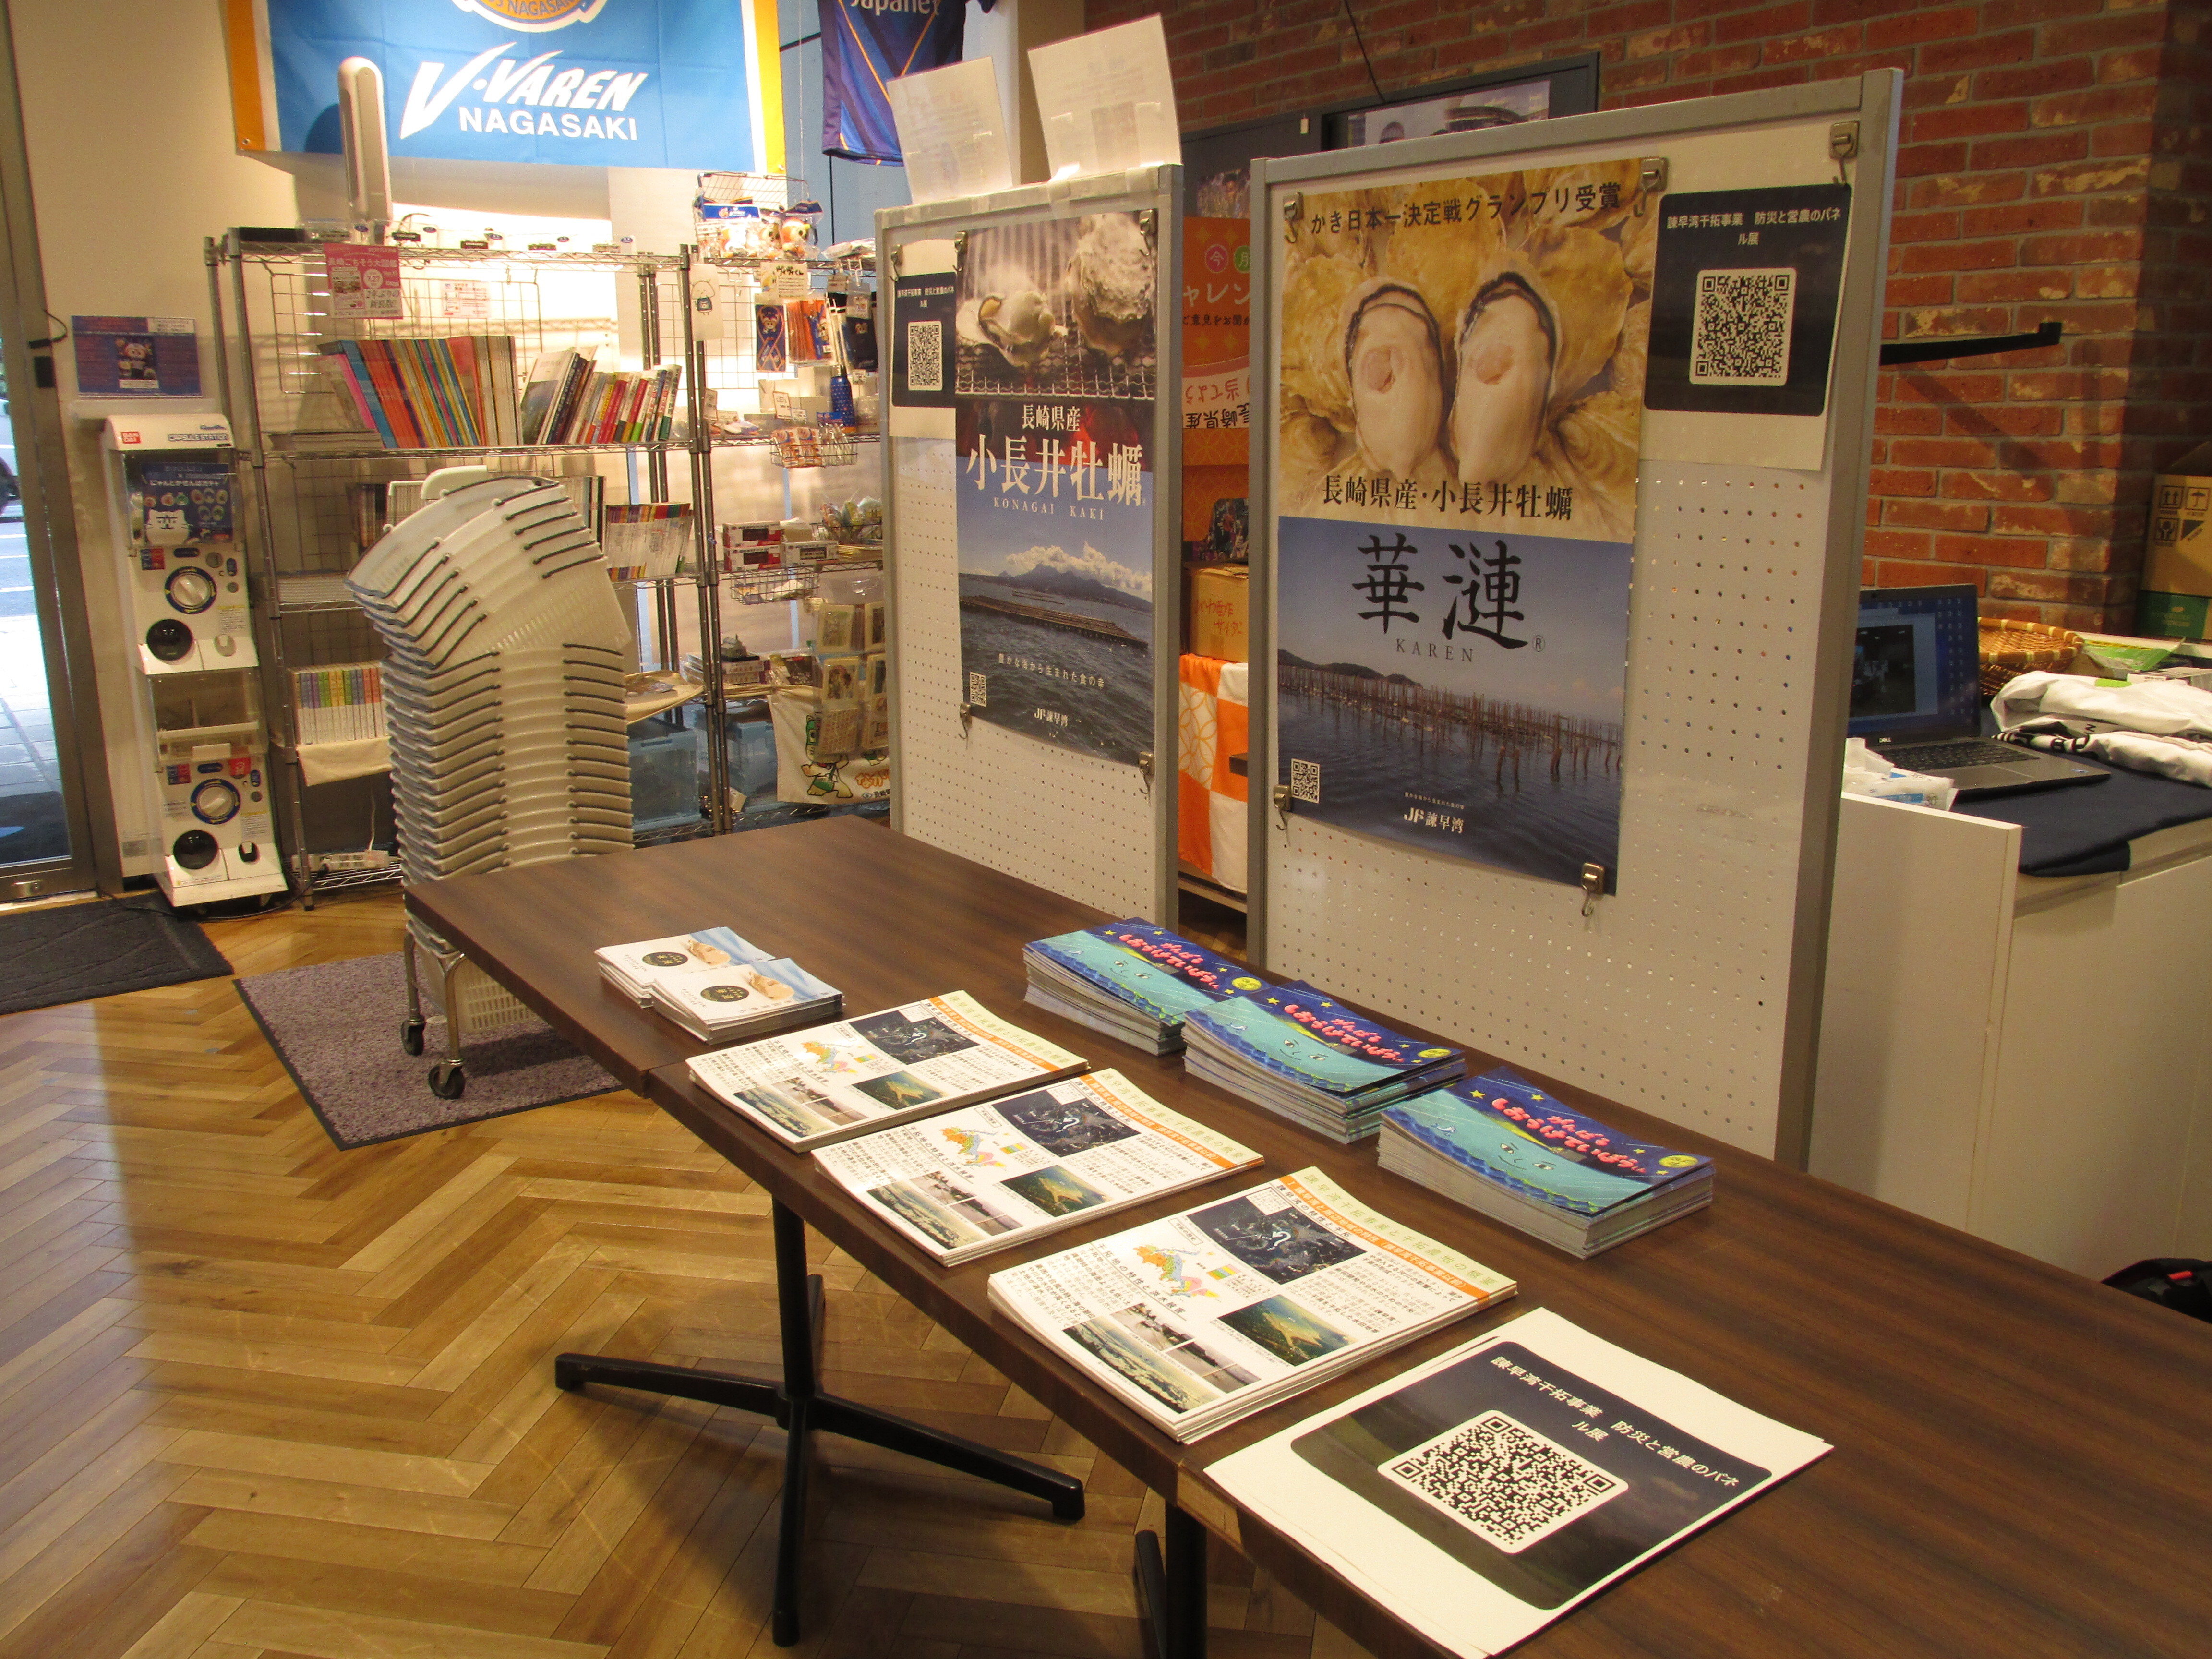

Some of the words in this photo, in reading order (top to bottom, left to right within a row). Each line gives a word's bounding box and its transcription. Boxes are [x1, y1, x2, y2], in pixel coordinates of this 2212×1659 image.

[459, 107, 637, 141] NAGASAKI
[1311, 182, 1621, 235] かき日本一決定戦グランプリ受賞
[1667, 213, 1743, 229] 諫早湾干拓事業
[1738, 232, 1759, 246] ル展
[1022, 404, 1081, 432] 長崎県産
[965, 434, 1144, 506] 小長井牡蠣
[993, 496, 1055, 515] KONAGAI
[1070, 505, 1104, 521] KAKI
[1323, 475, 1574, 520] 長崎県産・小長井牡蠣
[1352, 533, 1528, 649] 華漣
[1395, 638, 1474, 662] KAREN
[1094, 1243, 1187, 1314] 干拓地の特性と洪水被害
[1490, 1355, 1604, 1419] 諫早湾干拓事業
[1611, 1419, 1740, 1490] 防災と営農のパネ
[1571, 1419, 1607, 1443] ル展
